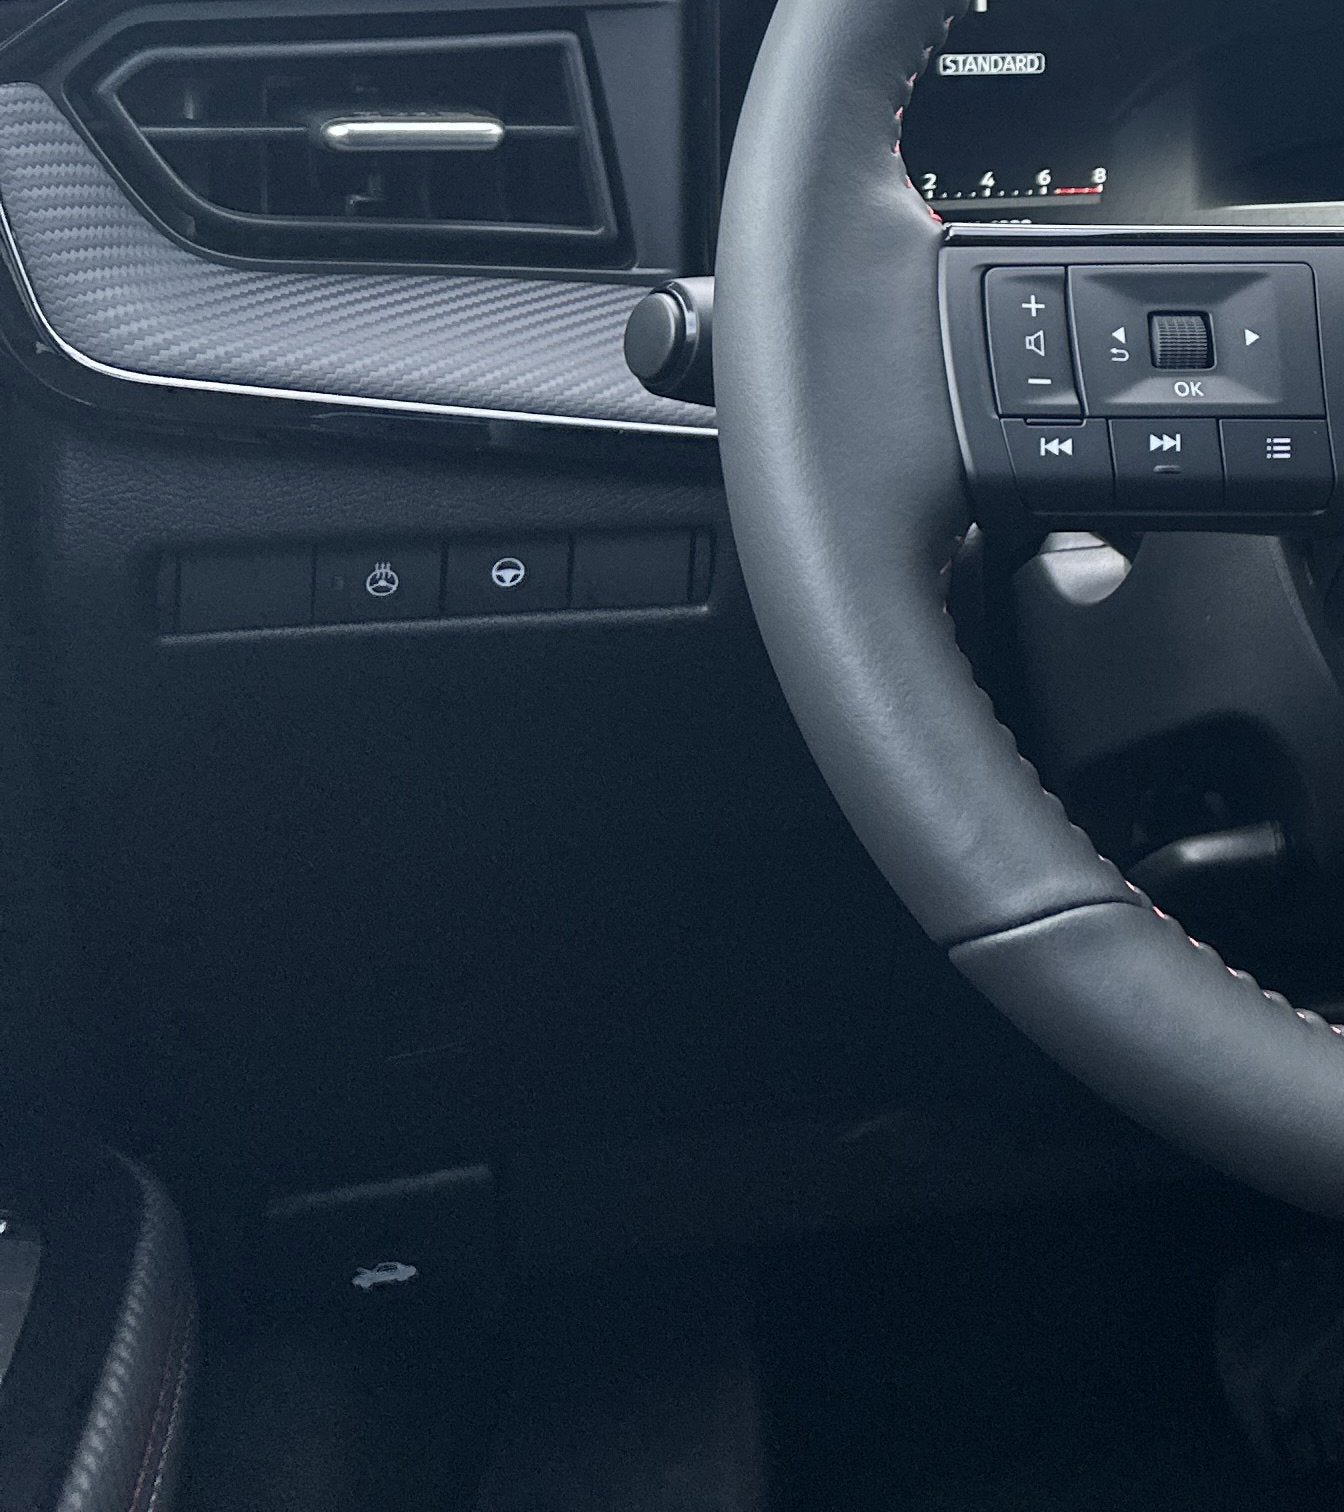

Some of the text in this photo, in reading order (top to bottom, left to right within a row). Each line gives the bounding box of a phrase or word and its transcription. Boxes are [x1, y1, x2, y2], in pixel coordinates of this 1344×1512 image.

[944, 55, 1040, 73] STANDARD
[923, 167, 1107, 190] 2 4 6 8
[1174, 381, 1204, 397] OK
